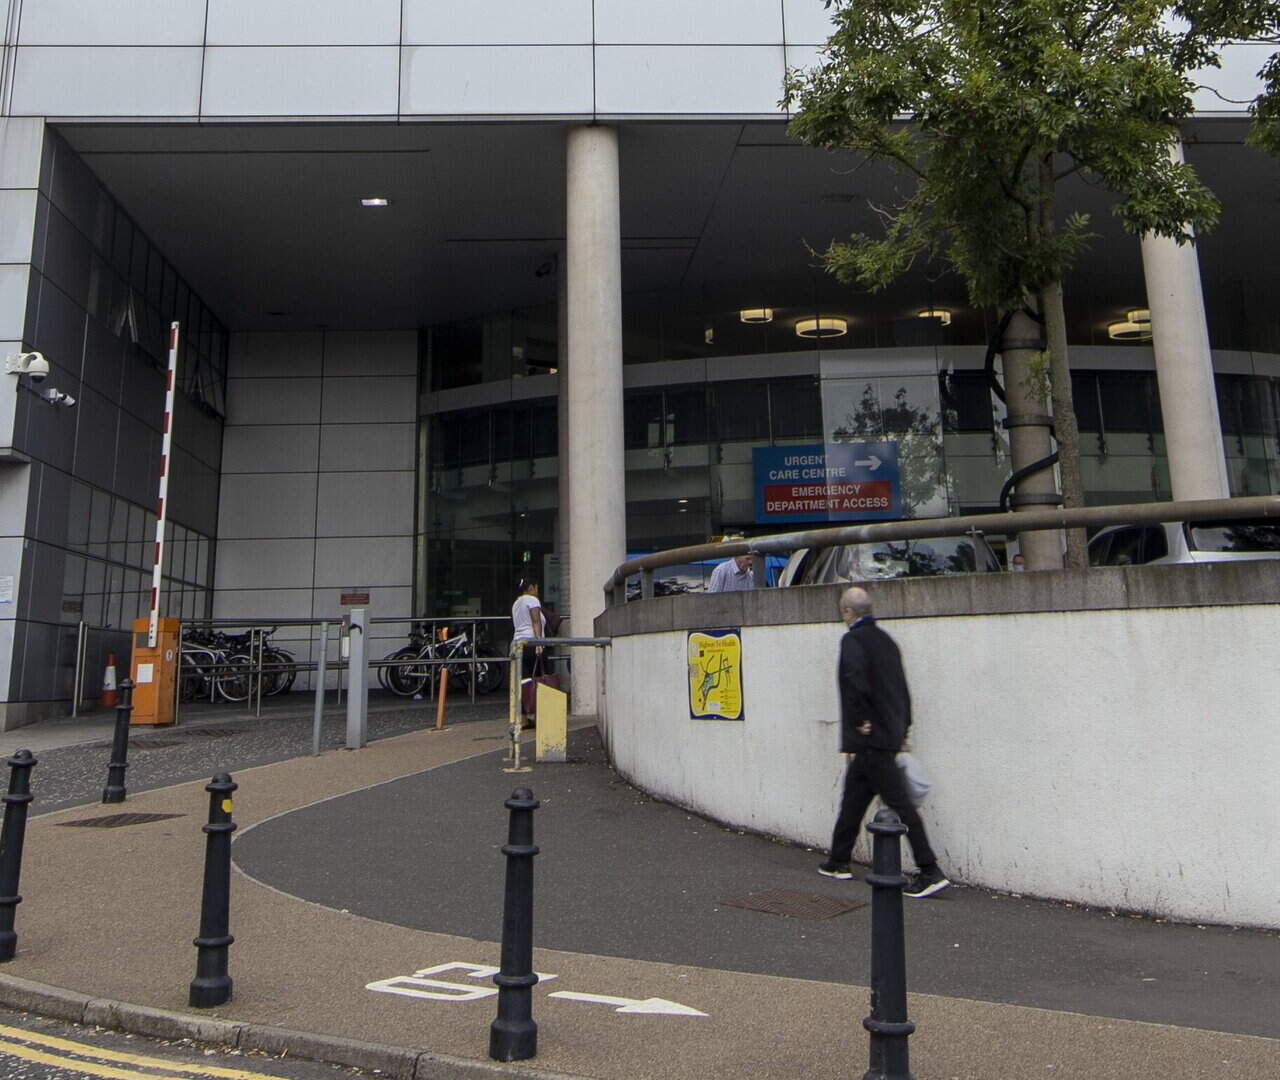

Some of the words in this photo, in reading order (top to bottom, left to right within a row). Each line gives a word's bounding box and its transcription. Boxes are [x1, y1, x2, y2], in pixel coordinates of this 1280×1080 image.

[784, 455, 828, 466] URGENT
[769, 470, 800, 480] CARE
[802, 467, 846, 479] CENTRE
[792, 485, 861, 497] EMERGENCY
[767, 499, 841, 512] DEPARTMENT
[843, 497, 888, 508] ACCESS
